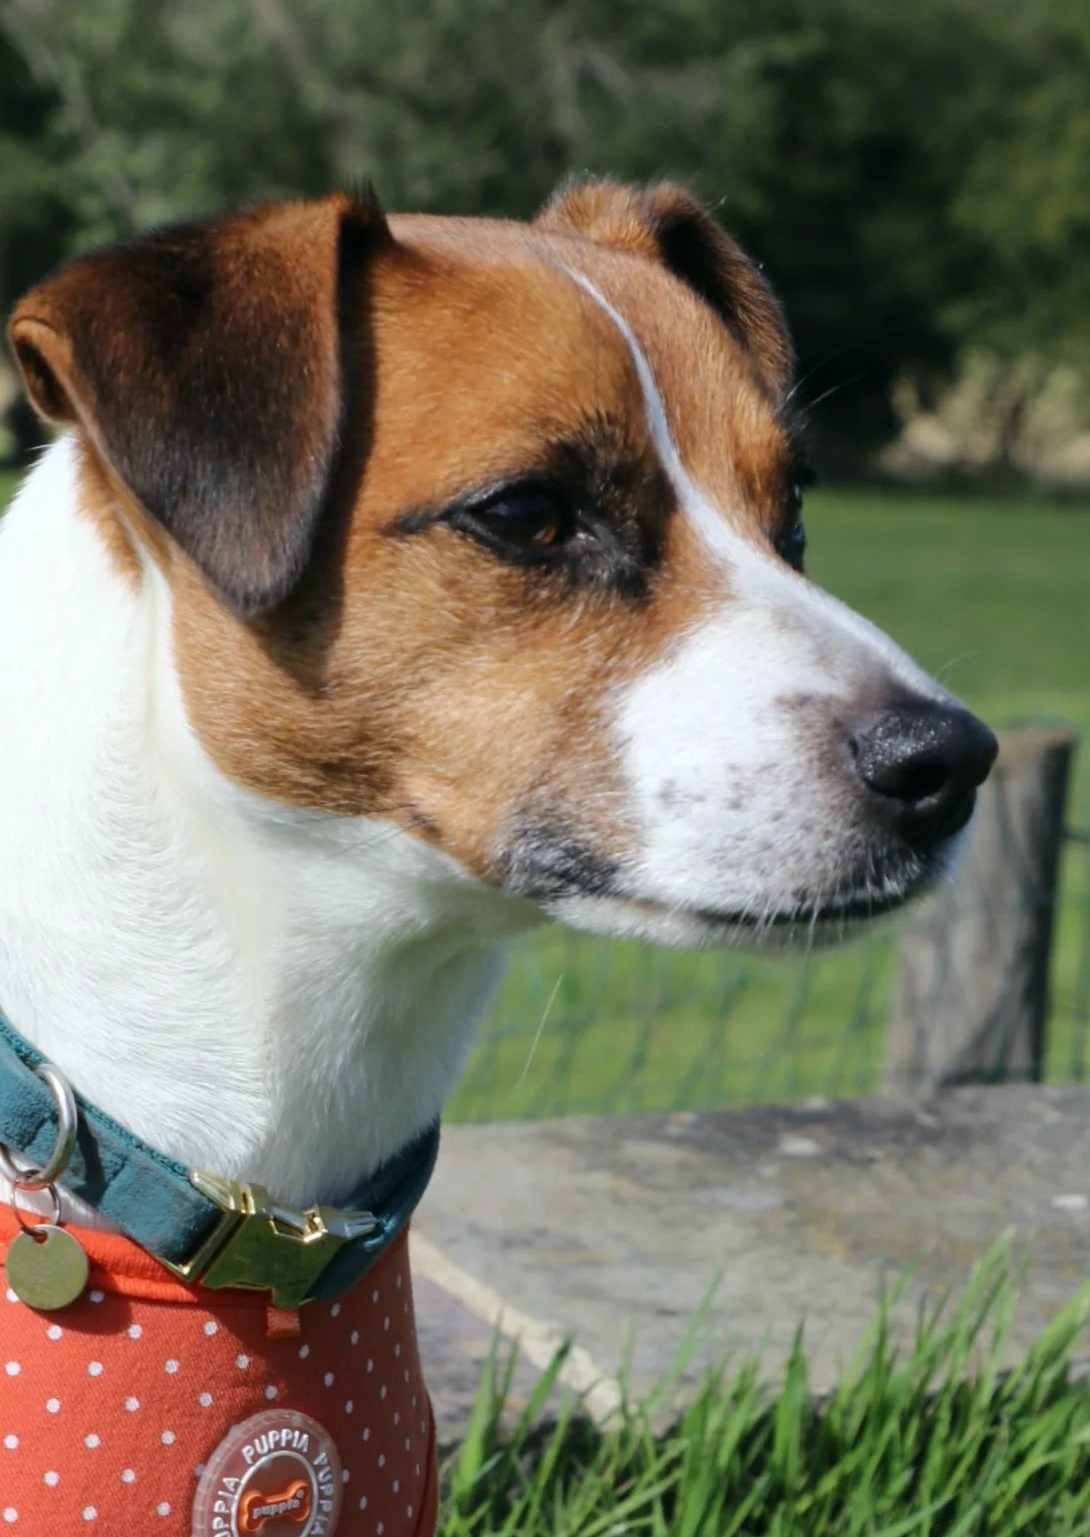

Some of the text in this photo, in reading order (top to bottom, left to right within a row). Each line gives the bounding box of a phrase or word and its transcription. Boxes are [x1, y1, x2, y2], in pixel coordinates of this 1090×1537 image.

[241, 1429, 310, 1465] PUPPIA
[252, 1499, 301, 1519] puppia
[311, 1452, 334, 1535] PUPPIA
